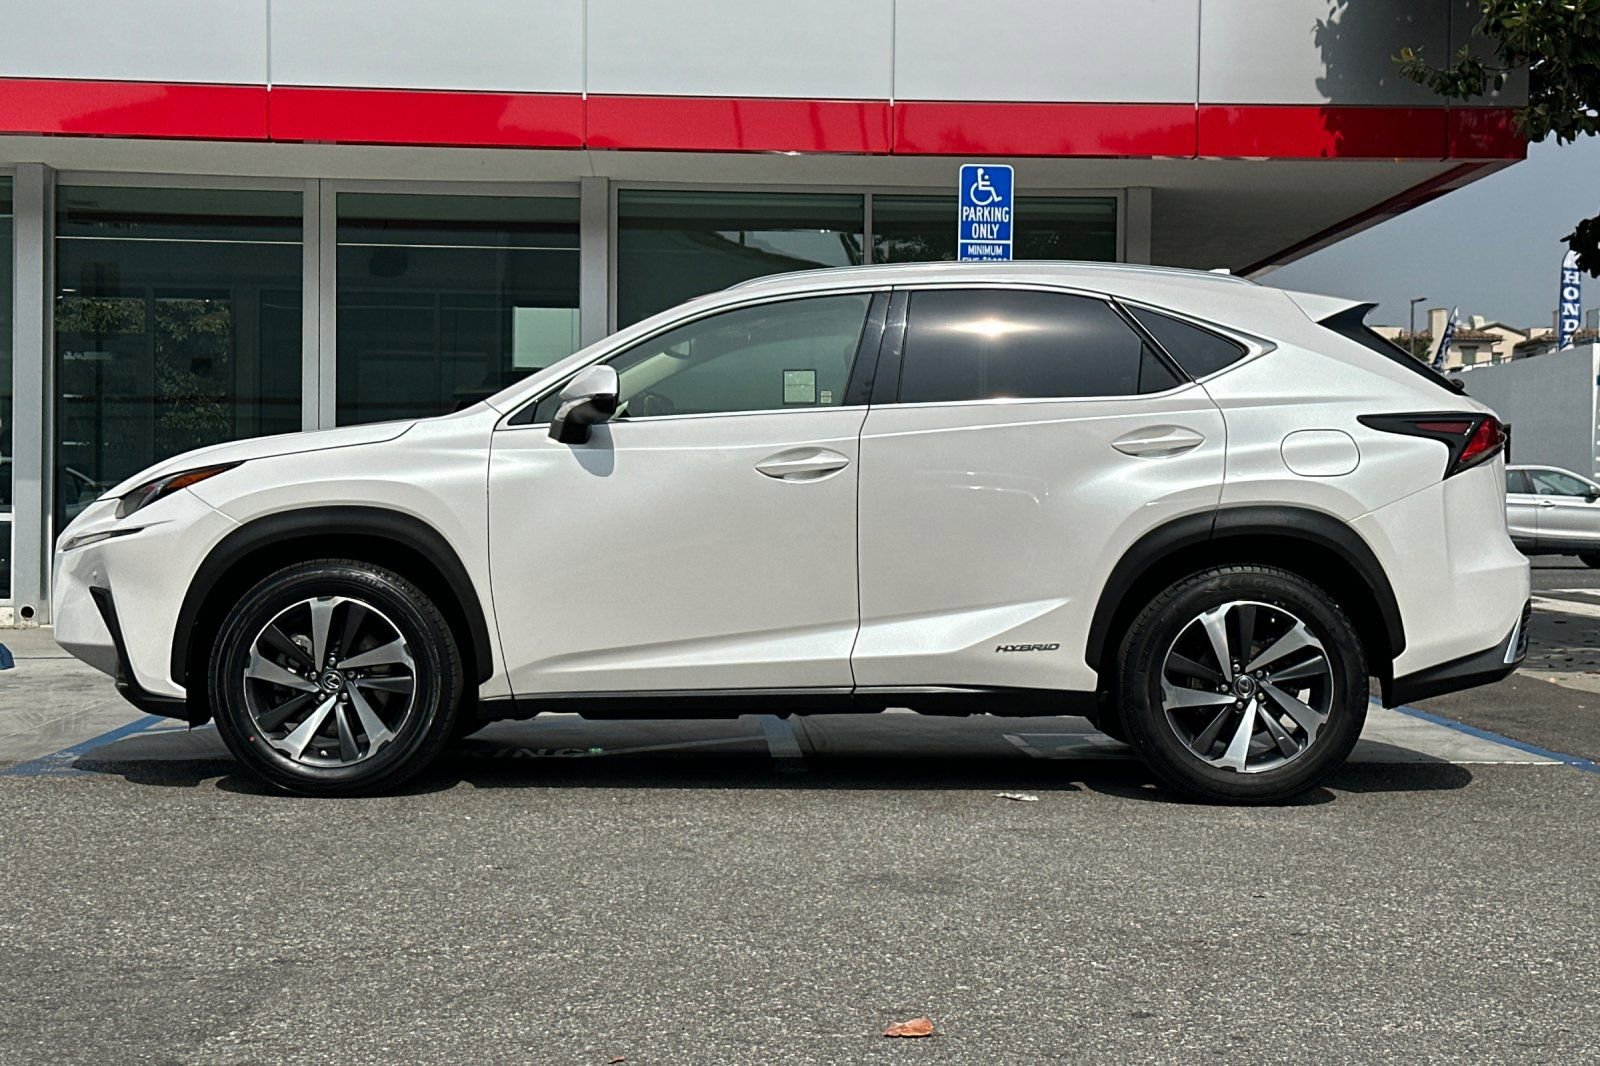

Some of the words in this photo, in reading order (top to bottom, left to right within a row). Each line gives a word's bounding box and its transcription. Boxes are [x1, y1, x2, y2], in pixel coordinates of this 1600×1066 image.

[962, 206, 1010, 223] PARKING
[971, 223, 1000, 239] ONLY
[967, 245, 1003, 256] MINIMUM
[995, 643, 1061, 653] HYBRID
